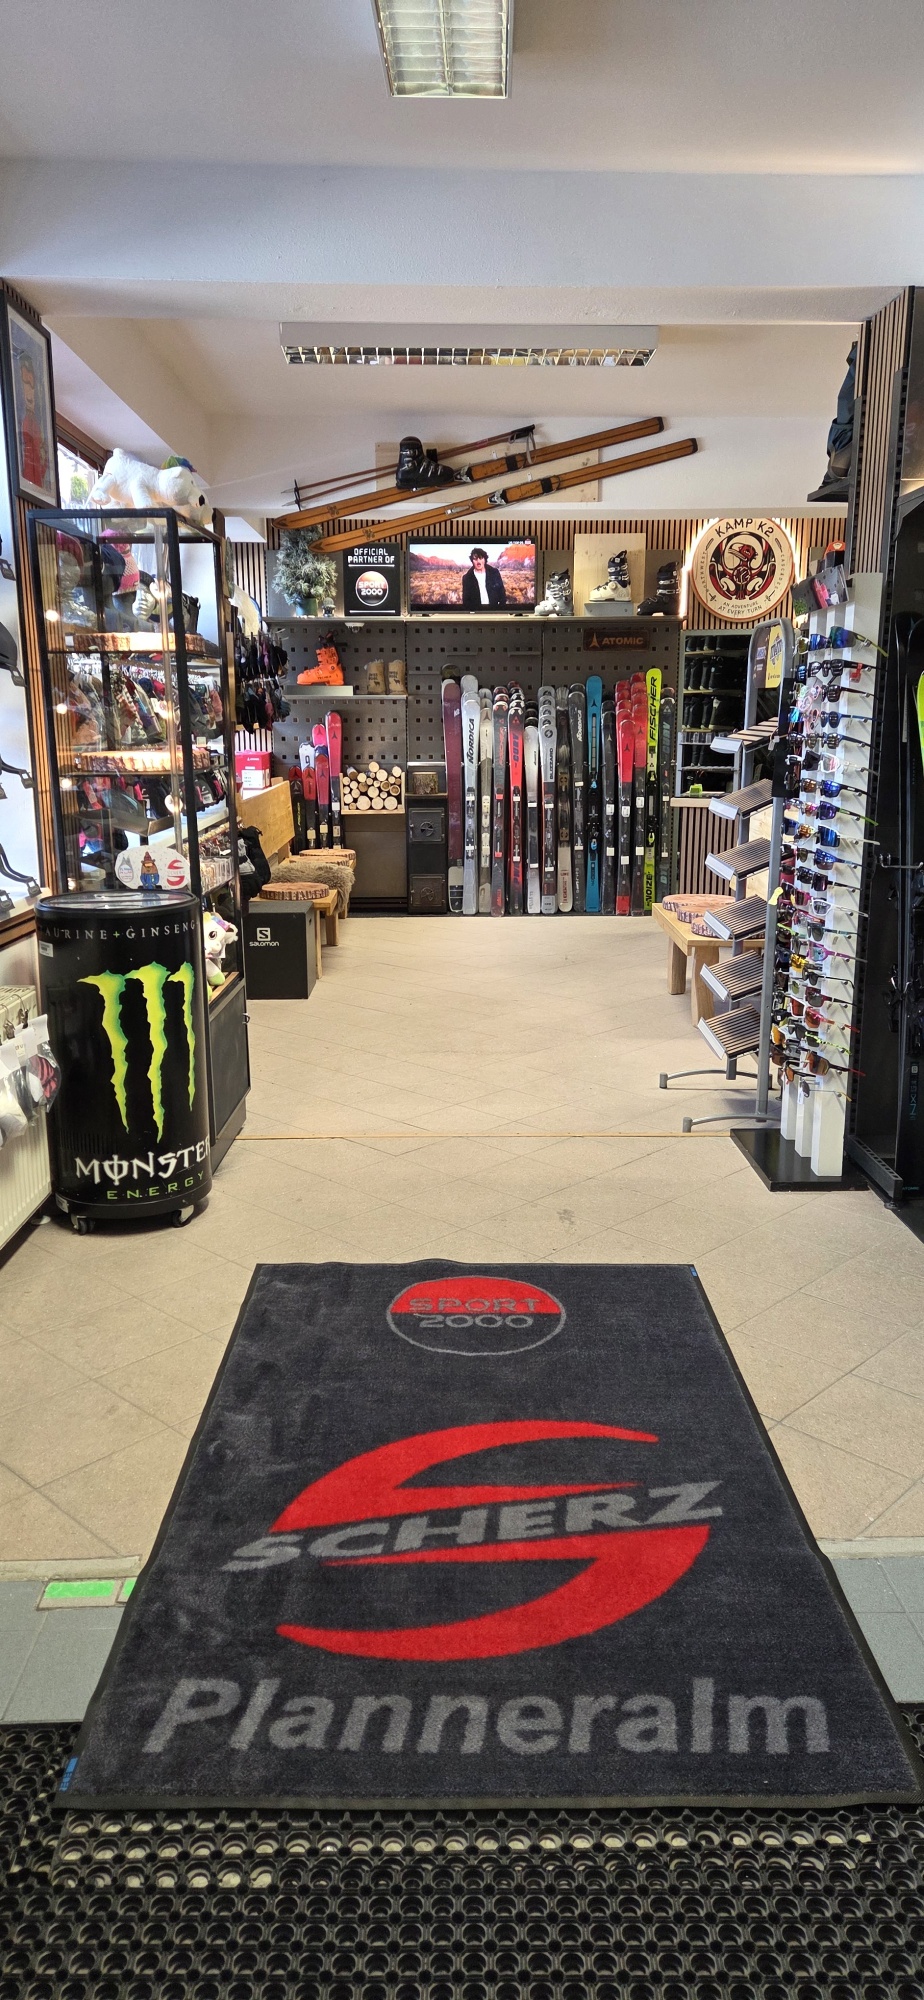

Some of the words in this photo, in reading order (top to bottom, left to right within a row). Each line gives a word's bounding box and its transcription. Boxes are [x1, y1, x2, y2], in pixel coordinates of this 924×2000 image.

[715, 518, 753, 537] KAMP
[757, 521, 774, 537] K2
[353, 547, 389, 556] OFFICIAL
[347, 555, 383, 564] PARTNER
[384, 555, 396, 564] OF
[358, 581, 385, 589] SPORT
[360, 588, 383, 596] 2000
[726, 608, 746, 616] EVERY
[747, 605, 763, 614] TURN
[731, 600, 759, 610] ADVENTURE
[602, 637, 644, 645] ATOMIC
[649, 676, 658, 741] FISCHER
[466, 718, 475, 765] NORDICA
[662, 721, 671, 756] CURV
[645, 874, 653, 902] NOIZE
[106, 1171, 204, 1200] ENERGY
[409, 1297, 540, 1312] SPORT
[418, 1314, 533, 1329] 2000
[220, 1480, 723, 1572] SCHERZ
[142, 1677, 830, 1755] Planneralm
